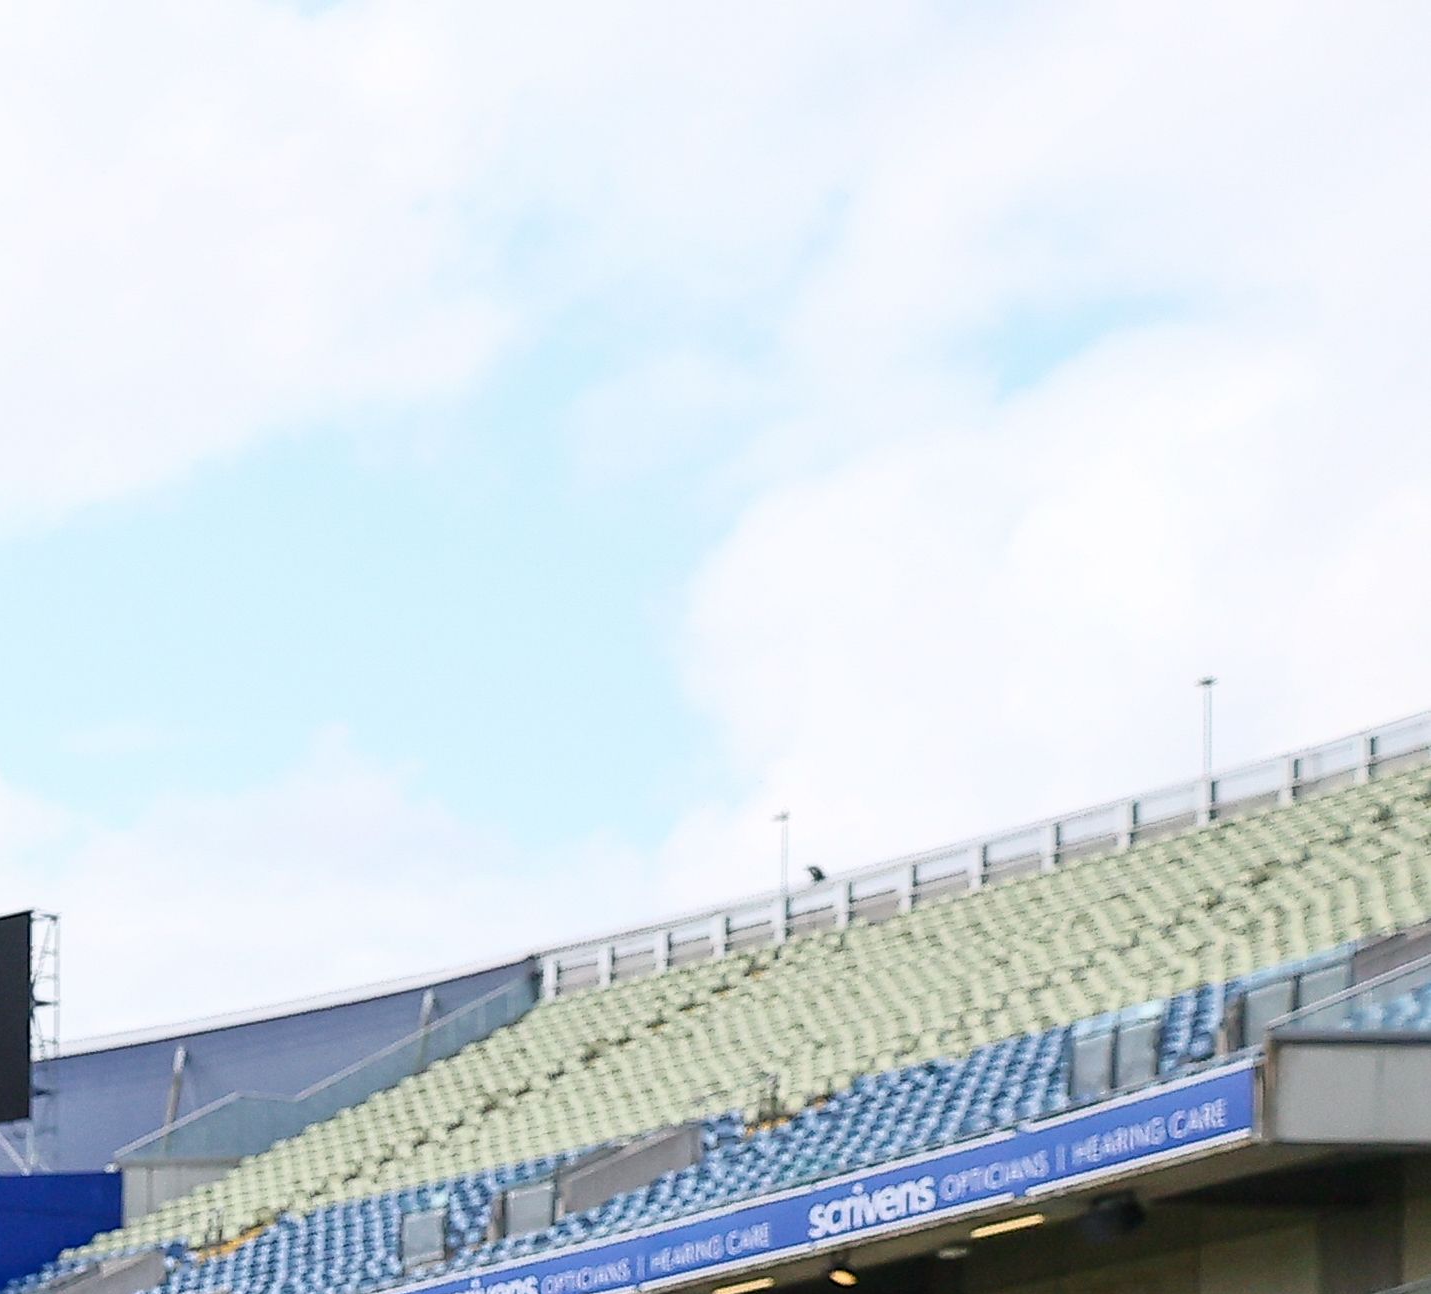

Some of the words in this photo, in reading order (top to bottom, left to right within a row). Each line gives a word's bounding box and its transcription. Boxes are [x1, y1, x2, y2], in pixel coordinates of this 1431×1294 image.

[808, 1176, 938, 1240] scrivens
[939, 1148, 1050, 1201] OPTICIANS
[1071, 1117, 1166, 1164] HEARING
[1167, 1098, 1229, 1138] CARE
[650, 1235, 724, 1274] HEARING
[725, 1222, 771, 1256] CARE
